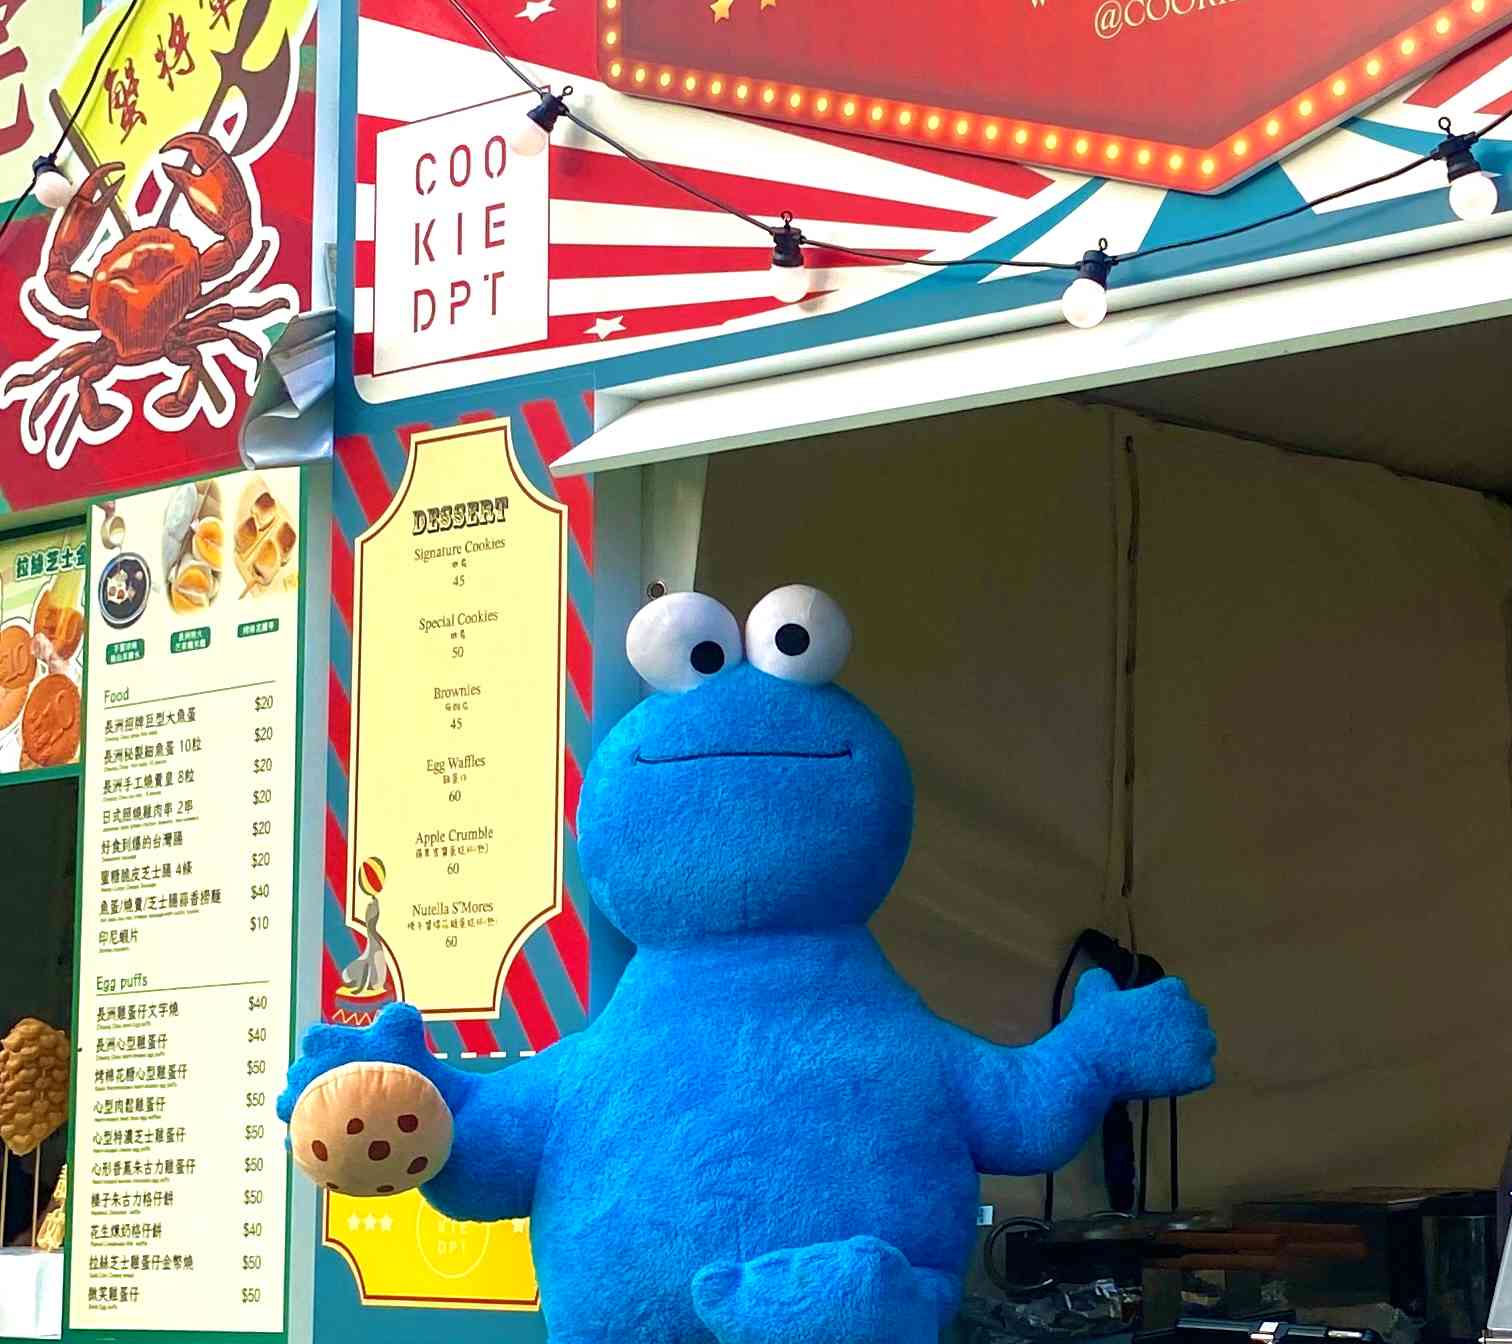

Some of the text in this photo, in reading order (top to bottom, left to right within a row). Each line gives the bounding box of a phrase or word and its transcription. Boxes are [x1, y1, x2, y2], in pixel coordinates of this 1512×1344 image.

[415, 135, 507, 196] COO
[413, 204, 506, 265] KIE
[412, 270, 505, 333] DPT
[412, 496, 508, 536] DESSERT
[414, 545, 461, 563] Signature
[465, 538, 505, 553] Cookies
[453, 574, 465, 586] 45
[419, 610, 498, 633] Special Cookies
[452, 646, 464, 658] 50
[104, 688, 129, 703] Food
[434, 683, 481, 699] Brownies
[255, 695, 273, 712] $20
[450, 717, 462, 729] 45
[255, 726, 273, 743] $20
[254, 758, 272, 774] $20
[427, 754, 486, 775] Egg Waffles
[253, 790, 272, 806] $20
[449, 790, 461, 802] 60
[252, 820, 271, 837] $20
[416, 826, 494, 847] Apple Crumble
[251, 852, 270, 868] $20
[447, 862, 460, 875] 60
[251, 884, 269, 900] $40
[412, 901, 448, 916] Nutella
[250, 916, 269, 932] $10
[445, 935, 458, 948] 60
[96, 973, 148, 991] Egg puffs
[248, 996, 267, 1011] $40
[248, 1027, 267, 1043] $40
[246, 1060, 265, 1075] $50
[246, 1092, 265, 1108] $50
[245, 1125, 264, 1140] $50
[244, 1157, 263, 1173] $50
[243, 1190, 263, 1205] $50
[243, 1222, 262, 1237] $40
[242, 1255, 261, 1270] $50
[241, 1287, 261, 1303] $50
